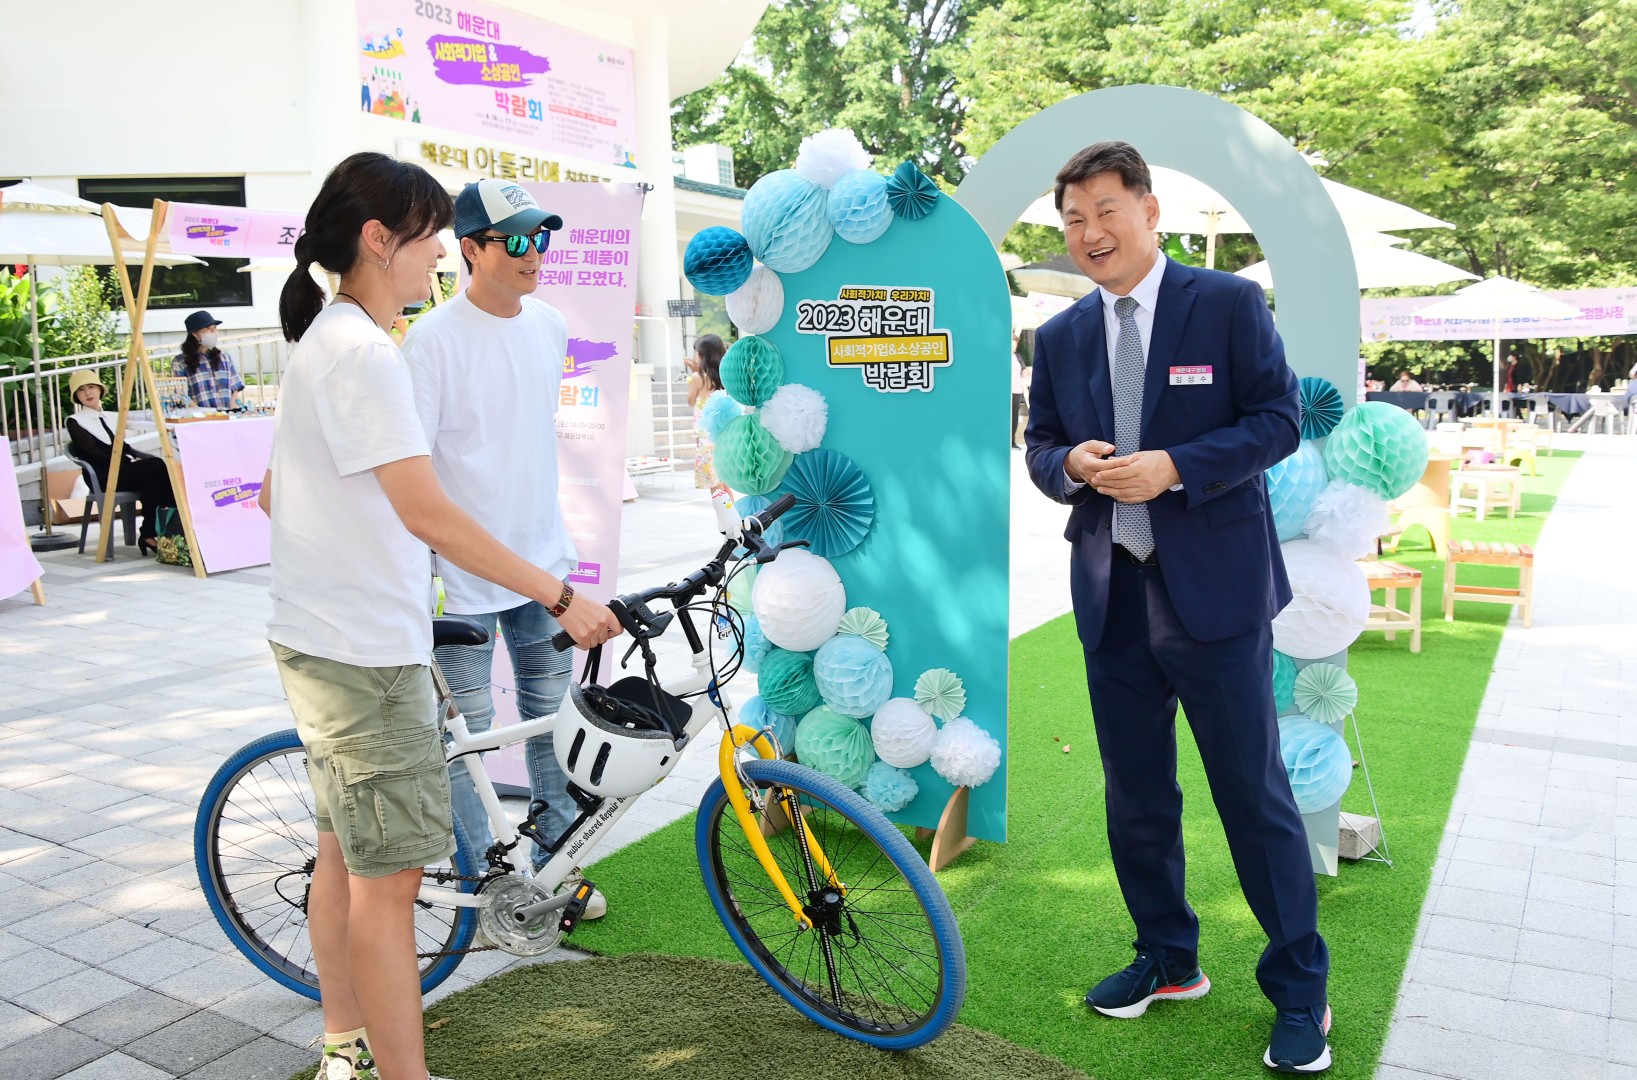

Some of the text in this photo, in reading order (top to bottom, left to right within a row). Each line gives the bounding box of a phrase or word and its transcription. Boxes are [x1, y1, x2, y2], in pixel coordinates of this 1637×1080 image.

[415, 0, 500, 41] 2023 해운대
[435, 42, 488, 63] 사회적기업
[481, 63, 522, 82] 소상공인
[495, 90, 543, 121] 박람회
[420, 140, 469, 169] 해운대
[570, 229, 630, 244] 해운대의
[582, 250, 629, 266] 제품이
[576, 271, 627, 288] 모였다.
[840, 289, 930, 302] 사회적가치! 우리가치!
[799, 304, 929, 335] 2023 해운대
[865, 362, 929, 389] 박람회
[560, 386, 599, 407] 람회
[567, 802, 619, 859] public shared Repair
